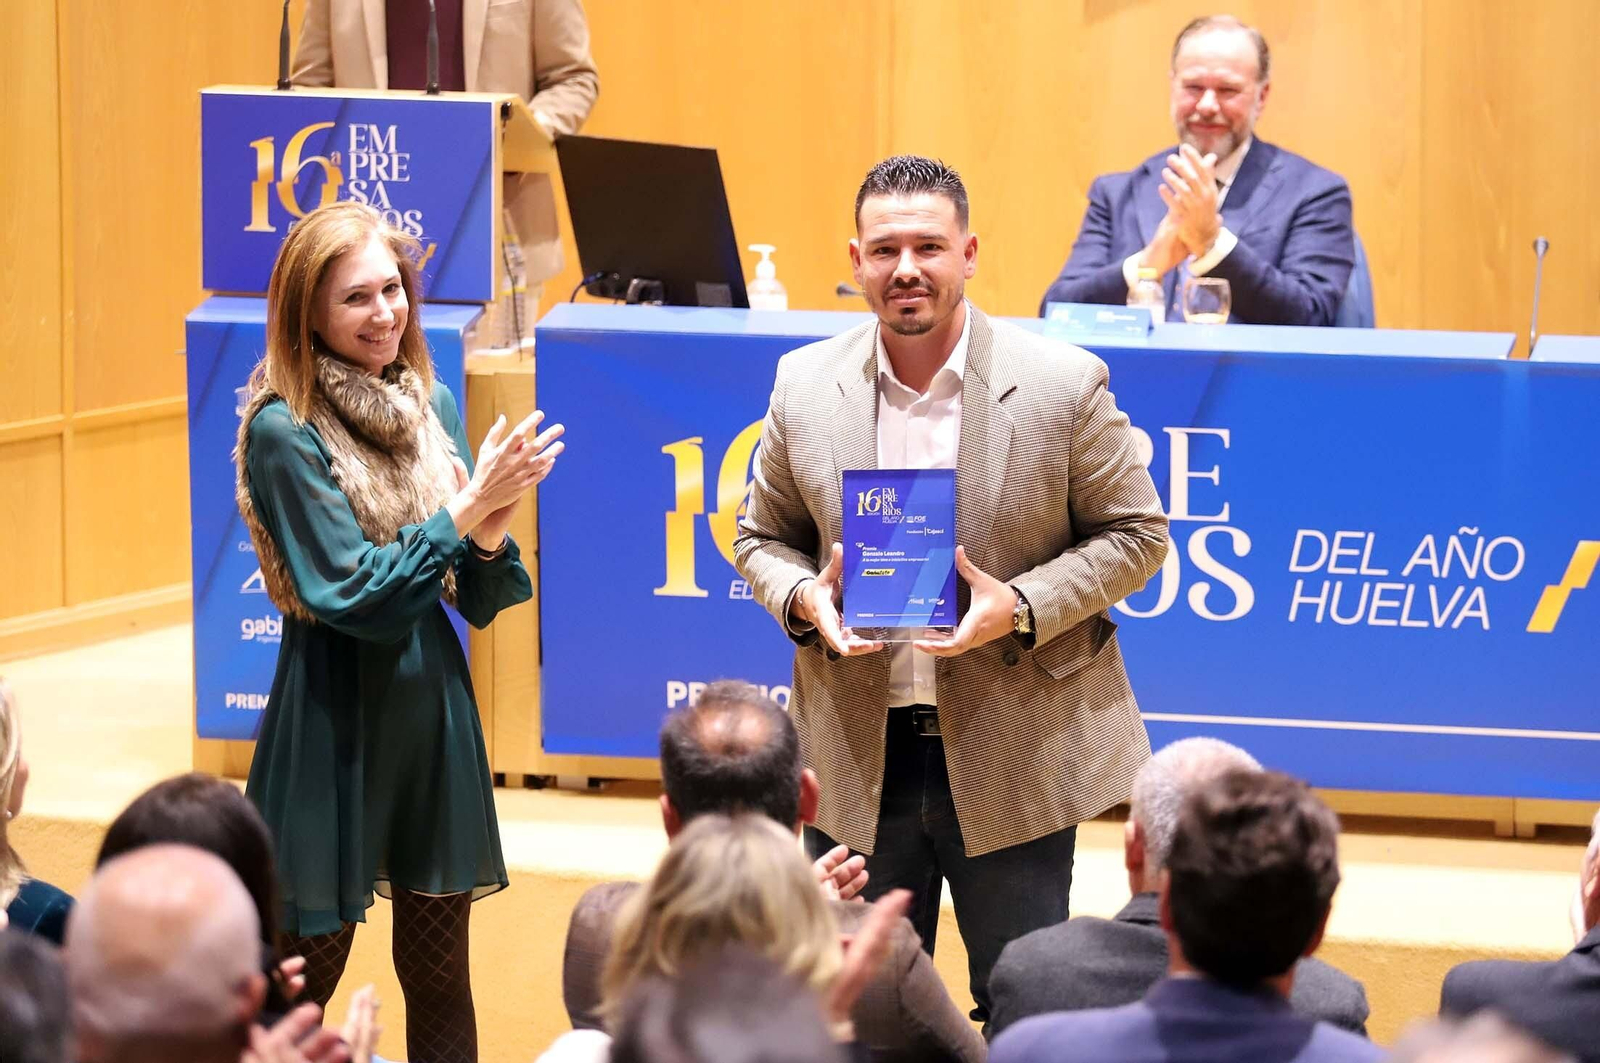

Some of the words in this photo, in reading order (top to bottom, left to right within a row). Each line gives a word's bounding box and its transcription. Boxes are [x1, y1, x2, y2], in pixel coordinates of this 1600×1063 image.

[348, 123, 397, 153] EM
[348, 151, 410, 182] PRE
[348, 179, 392, 209] SA
[882, 494, 898, 502] PRE
[882, 501, 894, 509] SA
[882, 508, 902, 516] RIOS
[1289, 528, 1389, 575] DEL
[1401, 526, 1526, 581] AÑO
[1288, 579, 1490, 630] HUELVA
